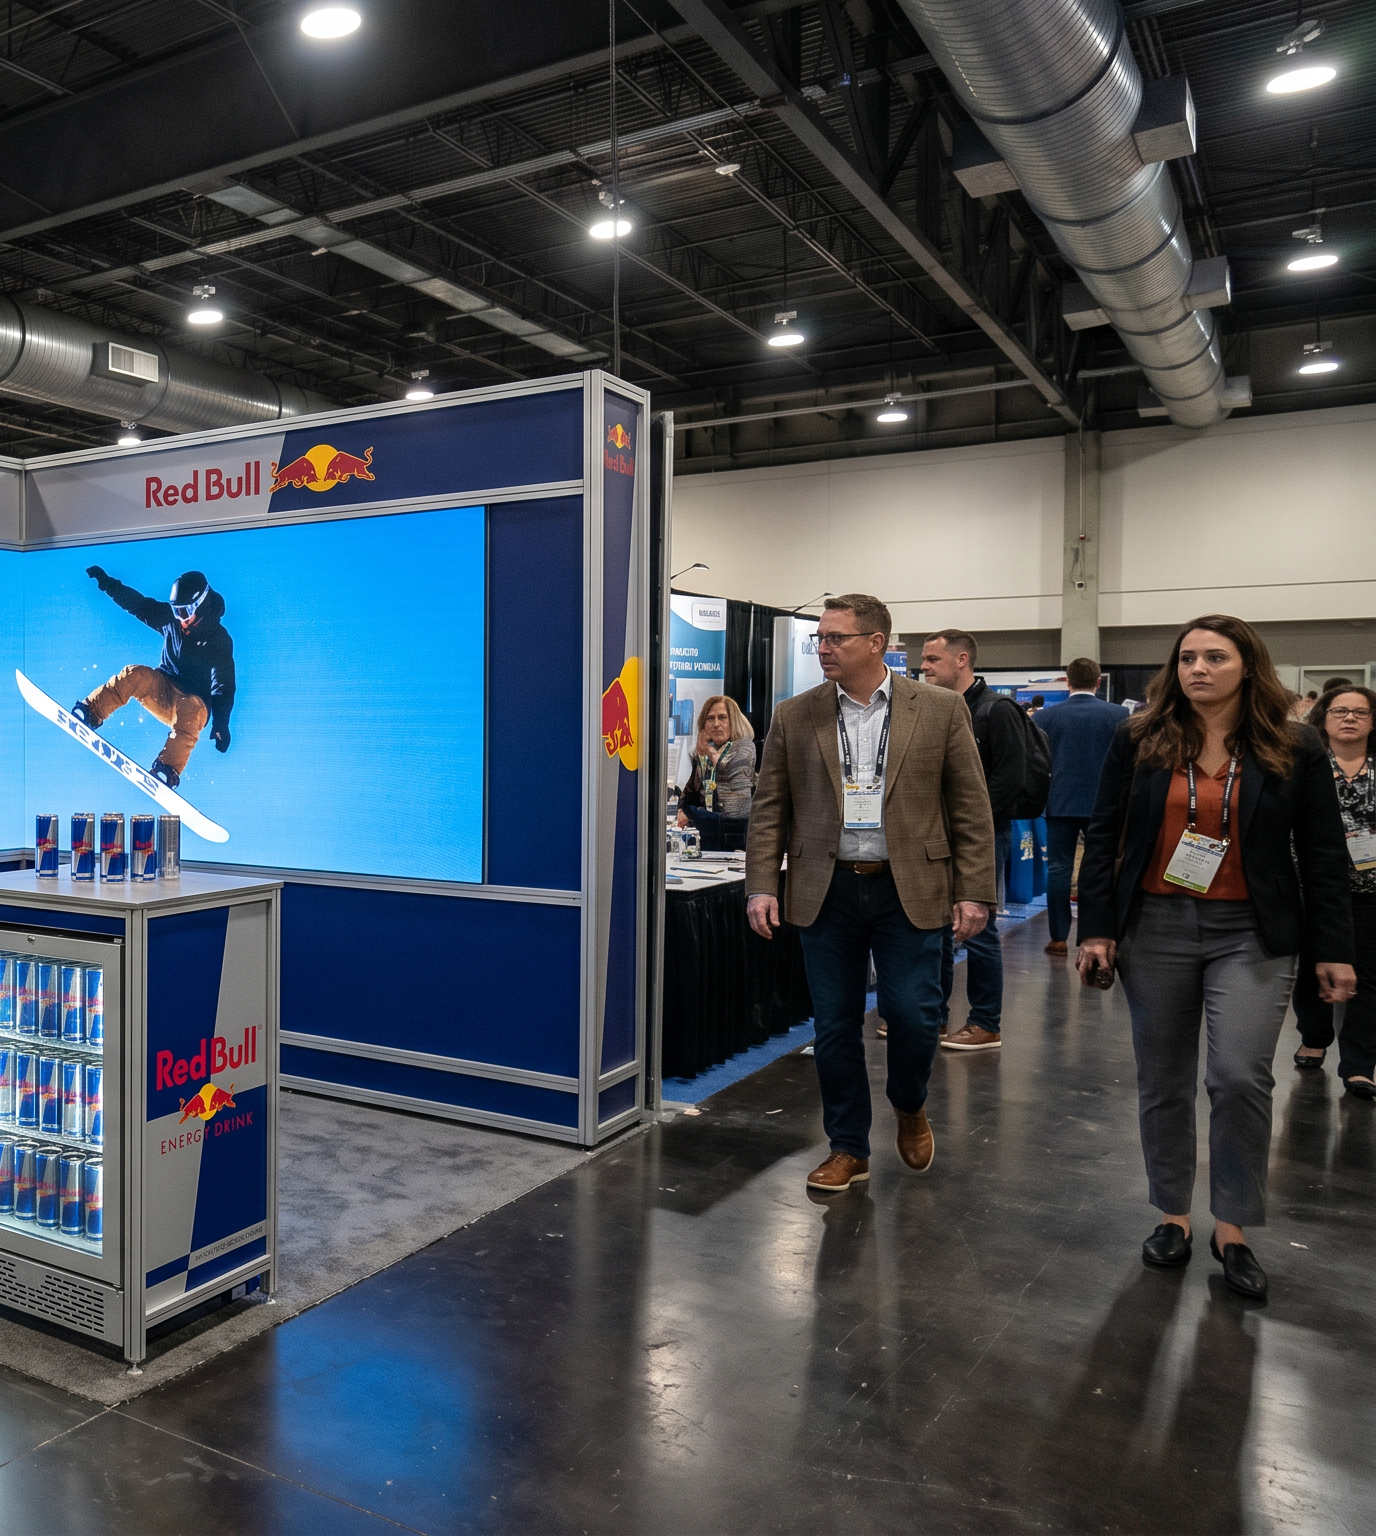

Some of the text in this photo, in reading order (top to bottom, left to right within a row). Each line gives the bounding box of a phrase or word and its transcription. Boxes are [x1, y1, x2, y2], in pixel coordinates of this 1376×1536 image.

[145, 461, 261, 509] Red Bull
[156, 1038, 207, 1091] Red
[210, 1025, 256, 1075] Bull
[161, 1111, 253, 1155] ENERGY DRINK
